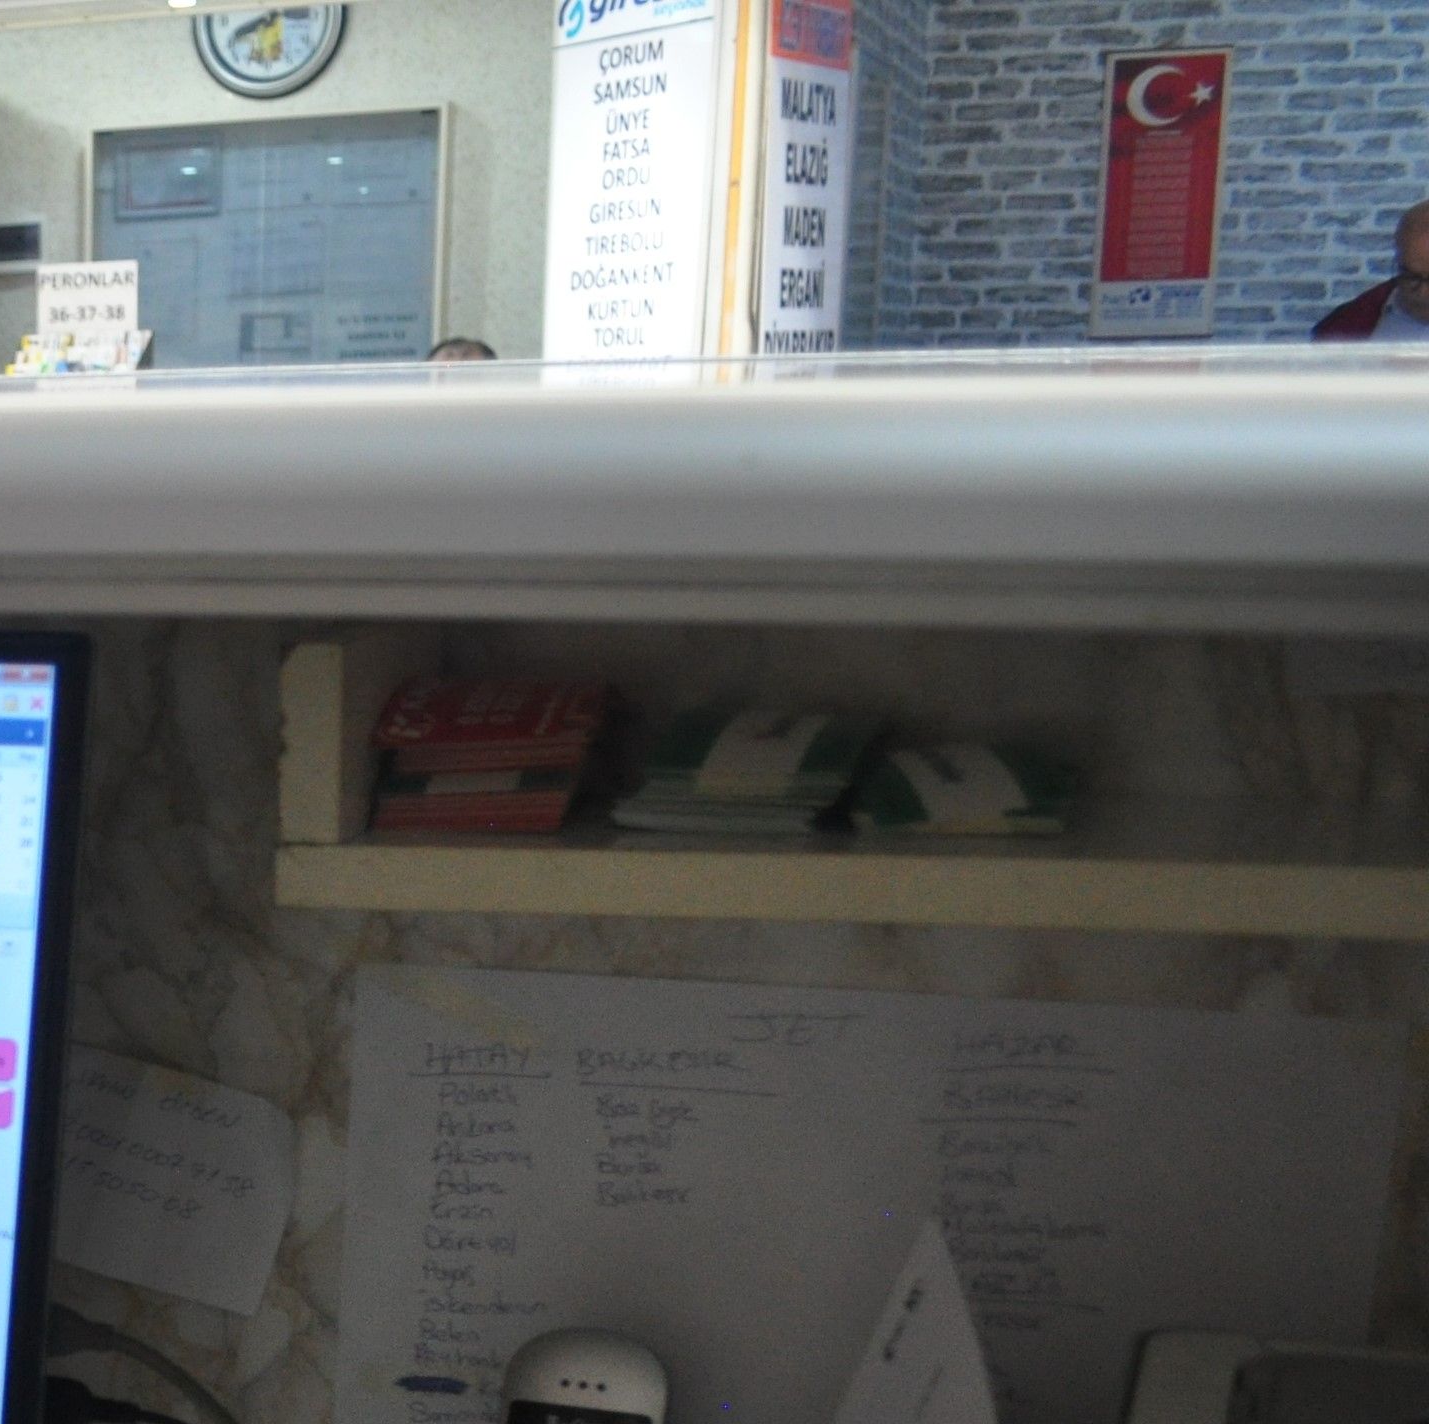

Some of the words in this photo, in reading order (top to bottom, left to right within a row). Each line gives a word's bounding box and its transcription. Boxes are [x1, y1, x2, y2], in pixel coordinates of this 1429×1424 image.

[598, 40, 665, 75] ÇORUM
[593, 73, 668, 105] SAMSUN
[780, 77, 837, 127] MALATYA
[606, 108, 651, 135] ÜNYE
[602, 138, 651, 163] FATSA
[784, 138, 829, 188] ELAZIĞ
[602, 167, 650, 190] ORDU
[783, 204, 827, 249] MADEN
[39, 269, 136, 291] PERONLAR
[779, 260, 826, 310] ERGANİ
[48, 303, 126, 324] 36-37-38
